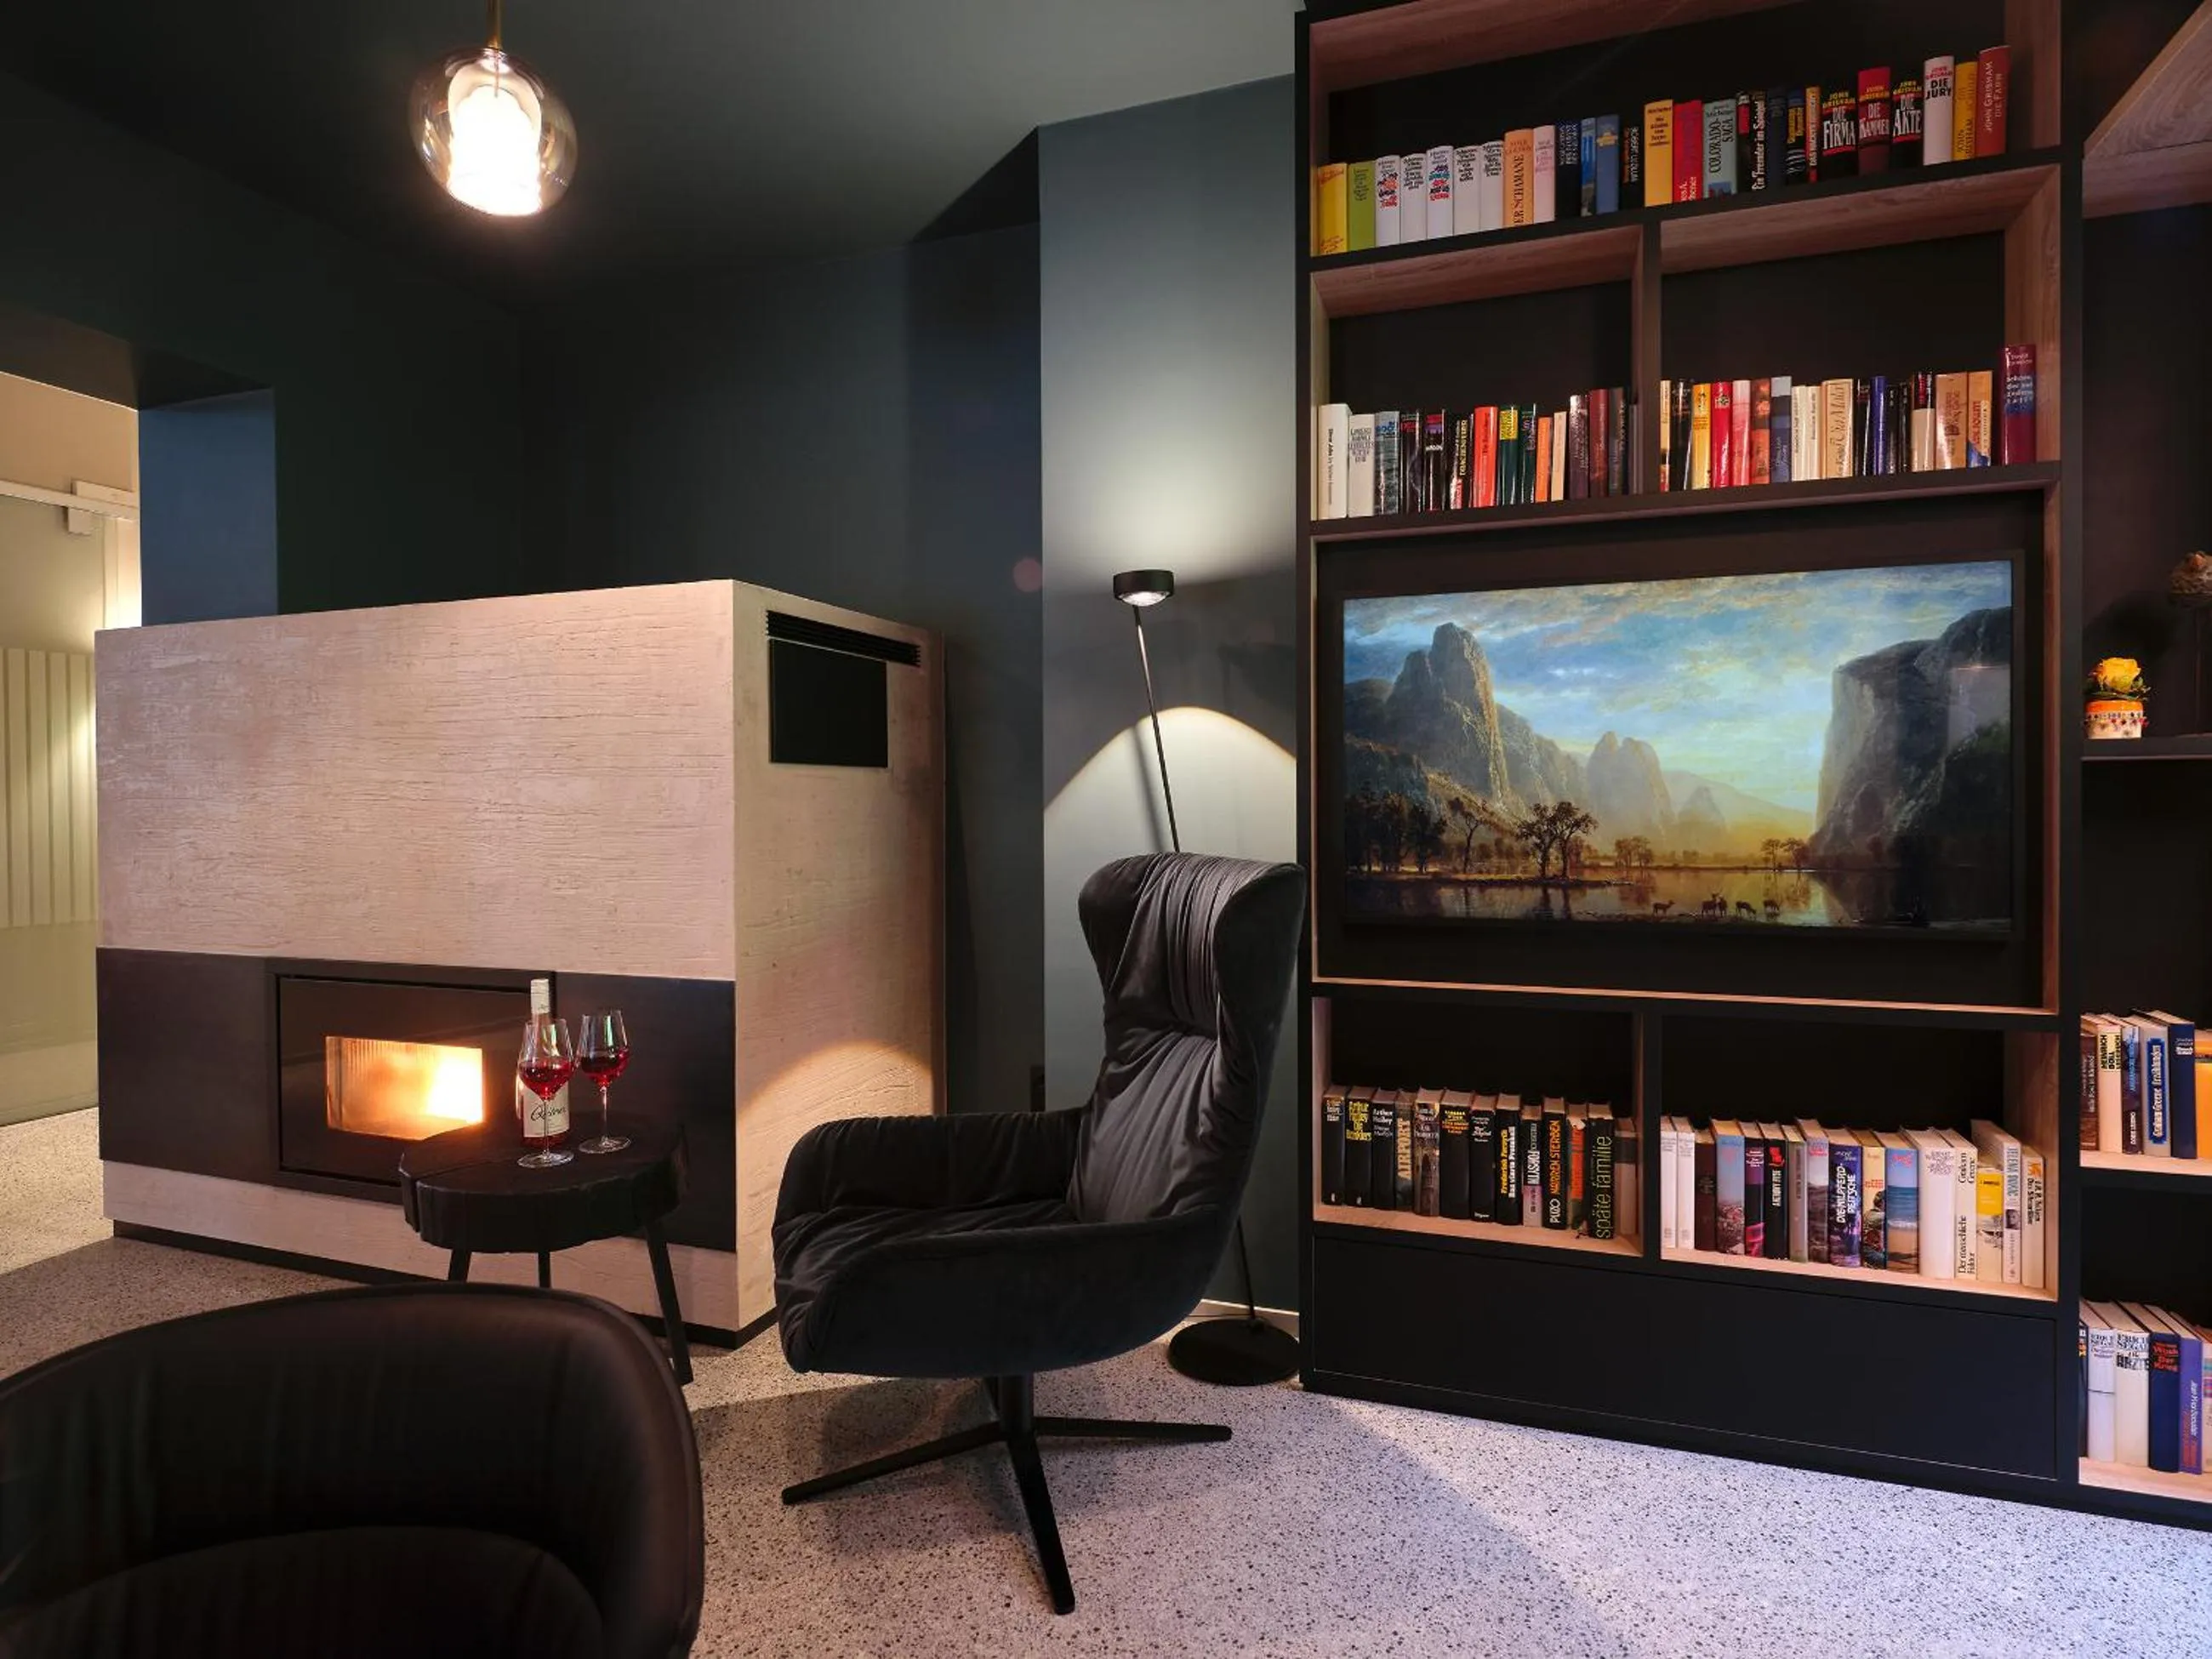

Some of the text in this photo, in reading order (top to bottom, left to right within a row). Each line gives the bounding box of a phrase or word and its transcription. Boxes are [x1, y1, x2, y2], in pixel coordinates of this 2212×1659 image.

[1925, 88, 1952, 100] JURY
[1930, 78, 1948, 88] DIE
[1867, 102, 1881, 119] DIE
[1900, 94, 1915, 111] DIE
[1982, 61, 1994, 134] JOHN GRISHAM
[1832, 106, 1846, 123] DIE
[1892, 109, 1923, 137] AKTE
[1822, 121, 1856, 150] FIRMA
[2100, 1034, 2108, 1069] HEINRICH
[1397, 1117, 1411, 1180] AIRPORT
[1549, 1120, 1561, 1159] STERBEN
[1527, 1150, 1541, 1184] FORSYTH
[1593, 1136, 1614, 1239] späte familie
[1847, 1174, 1857, 1214] PEITSCHE
[1549, 1198, 1561, 1223] PUZO
[1958, 1259, 1967, 1274] Der
